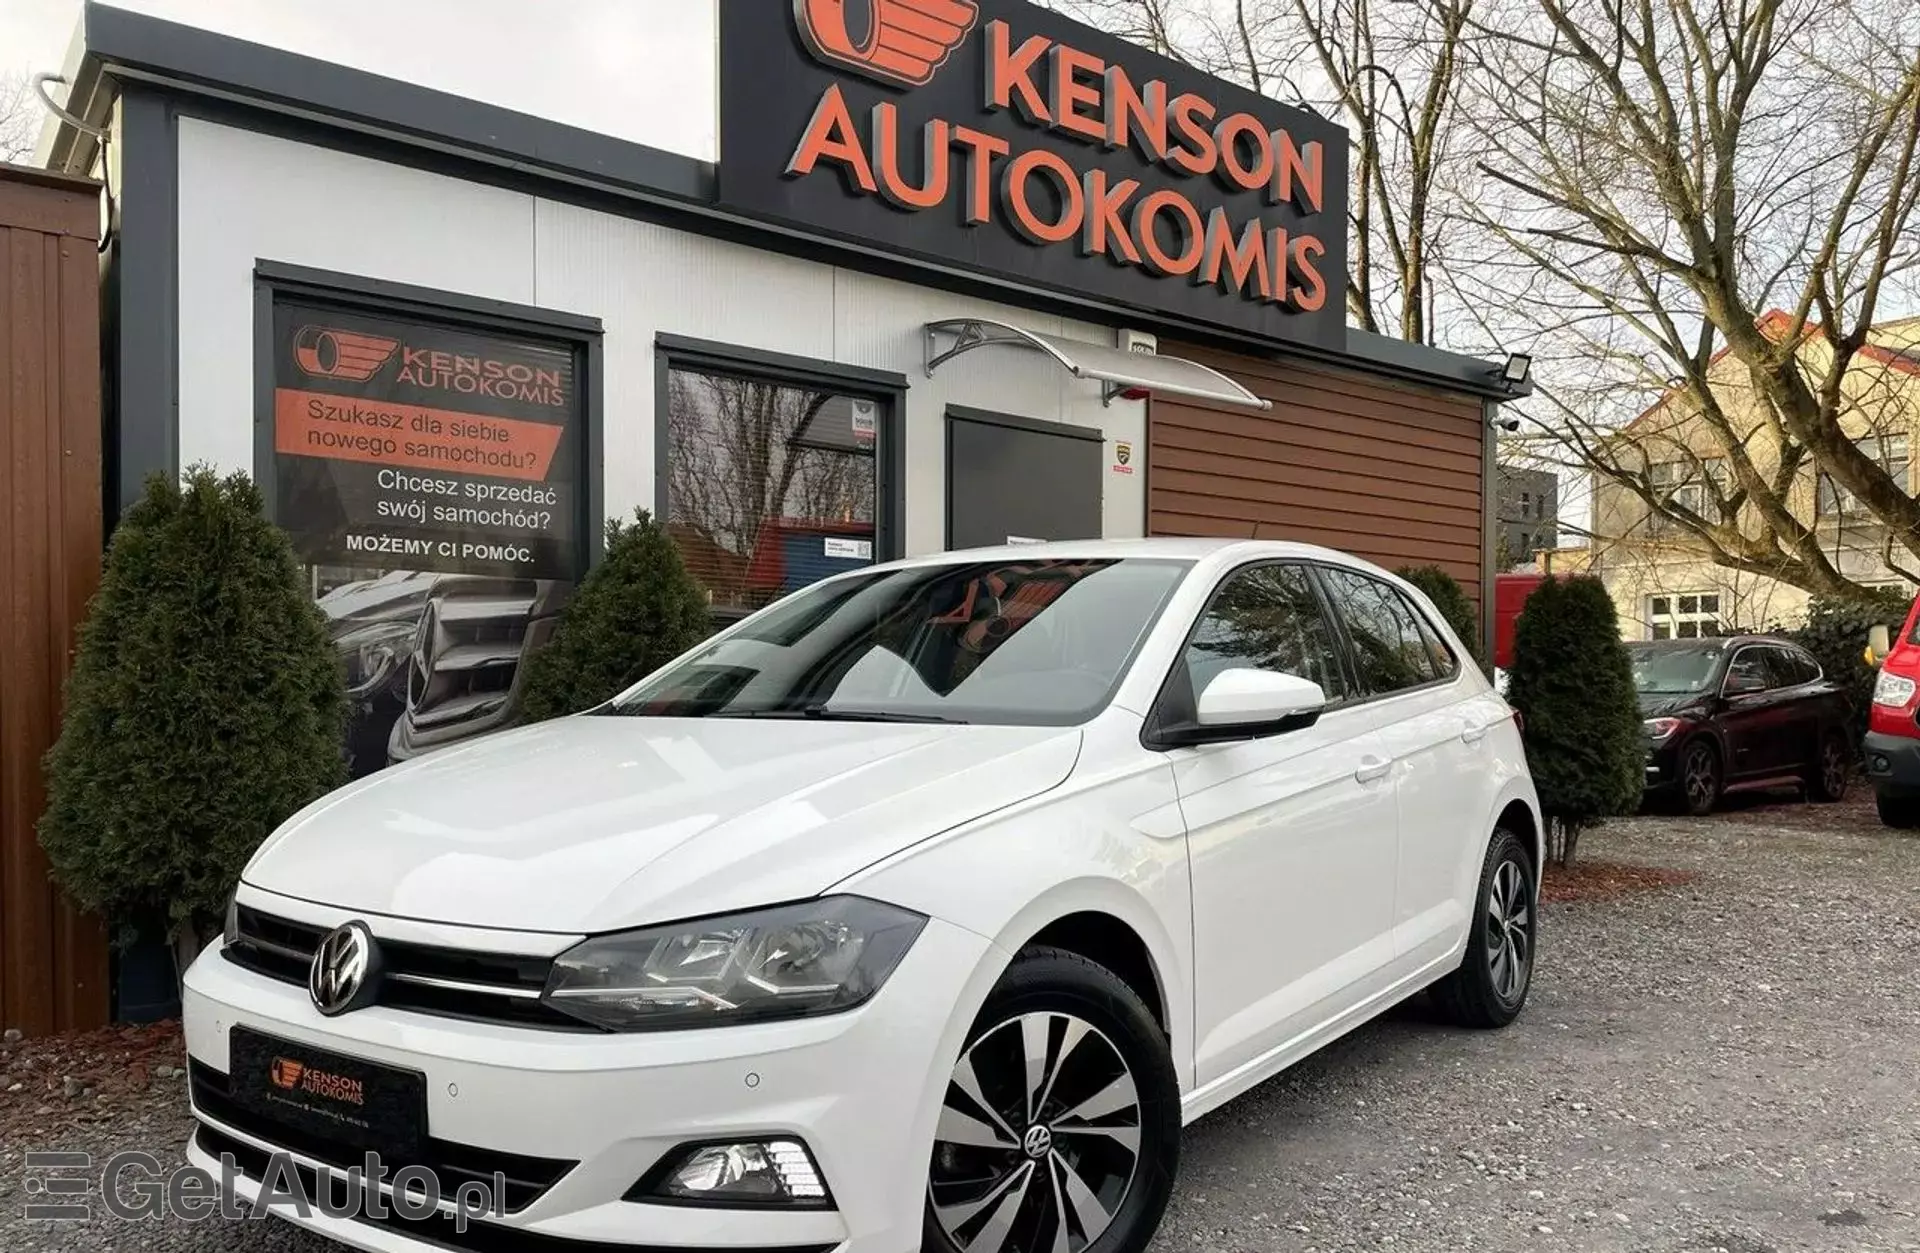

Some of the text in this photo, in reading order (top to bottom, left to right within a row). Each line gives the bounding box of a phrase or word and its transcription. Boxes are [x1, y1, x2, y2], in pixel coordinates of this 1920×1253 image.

[984, 18, 1322, 213] KENSON
[783, 83, 1326, 313] AUTOKOMIS
[403, 346, 560, 387] KENSON
[396, 367, 565, 407] AUTOKOMIS
[308, 399, 510, 443] Szukasz dla siebie
[308, 429, 537, 470] nowego samochodu?
[377, 469, 557, 506] Chcesz sprzedać
[377, 500, 550, 530] swój samochód?
[346, 534, 535, 564] MOŻEMY CI POMÓC.
[301, 1081, 364, 1105] AUTOKOMIS
[303, 1068, 363, 1092] KENSON
